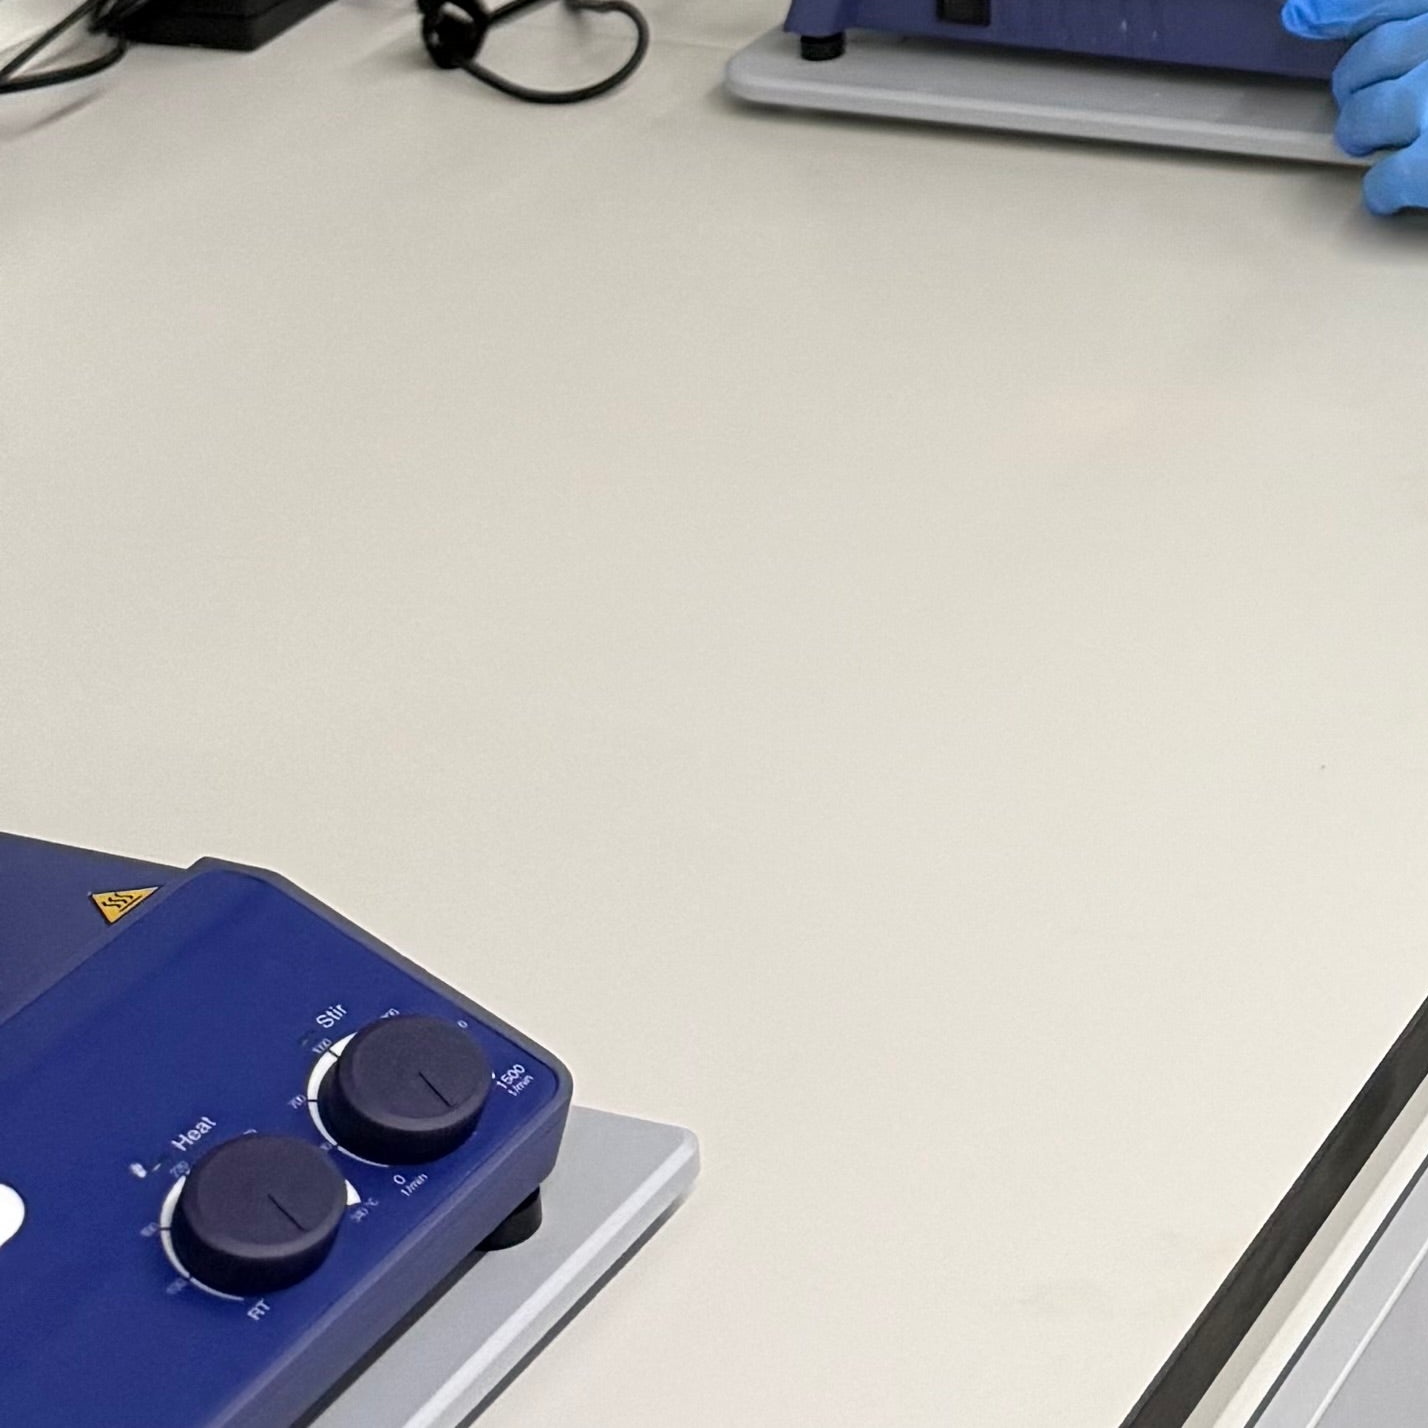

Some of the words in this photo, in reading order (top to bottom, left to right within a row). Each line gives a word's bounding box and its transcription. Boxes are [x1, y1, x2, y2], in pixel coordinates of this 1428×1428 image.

[315, 1004, 348, 1029] Stir
[496, 1063, 526, 1090] 1500
[171, 1116, 217, 1152] Heat
[392, 1173, 405, 1186] 0
[246, 1298, 271, 1321] RT
